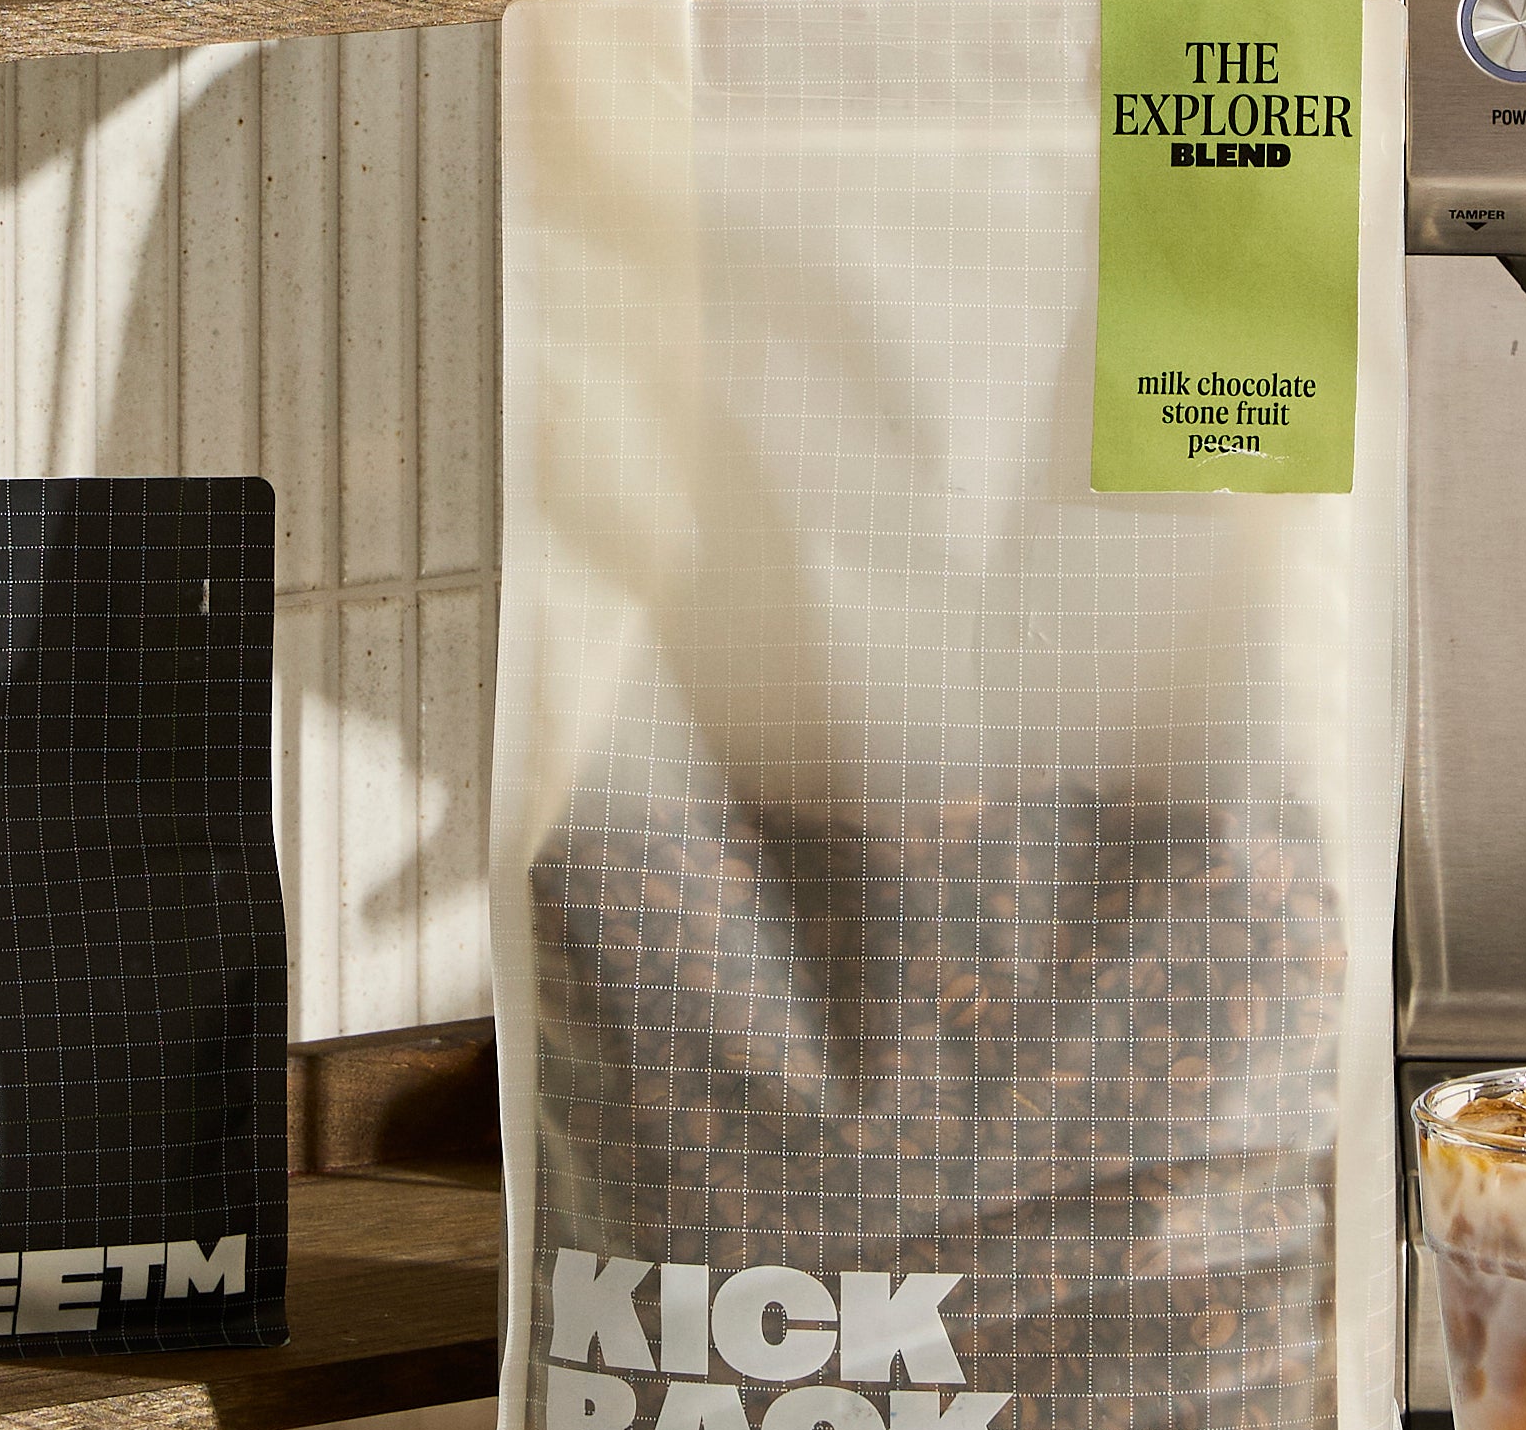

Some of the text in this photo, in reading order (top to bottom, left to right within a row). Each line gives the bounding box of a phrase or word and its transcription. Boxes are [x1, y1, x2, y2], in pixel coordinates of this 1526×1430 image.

[1186, 42, 1280, 84] THE
[1112, 94, 1353, 138] EXPLORER
[1171, 143, 1292, 168] BLEND
[1449, 209, 1505, 221] TAMPER
[1137, 372, 1316, 399] milk chocolate
[1162, 402, 1290, 426] stone fruit
[1188, 431, 1261, 459] pecan
[549, 1247, 967, 1385] KICK
